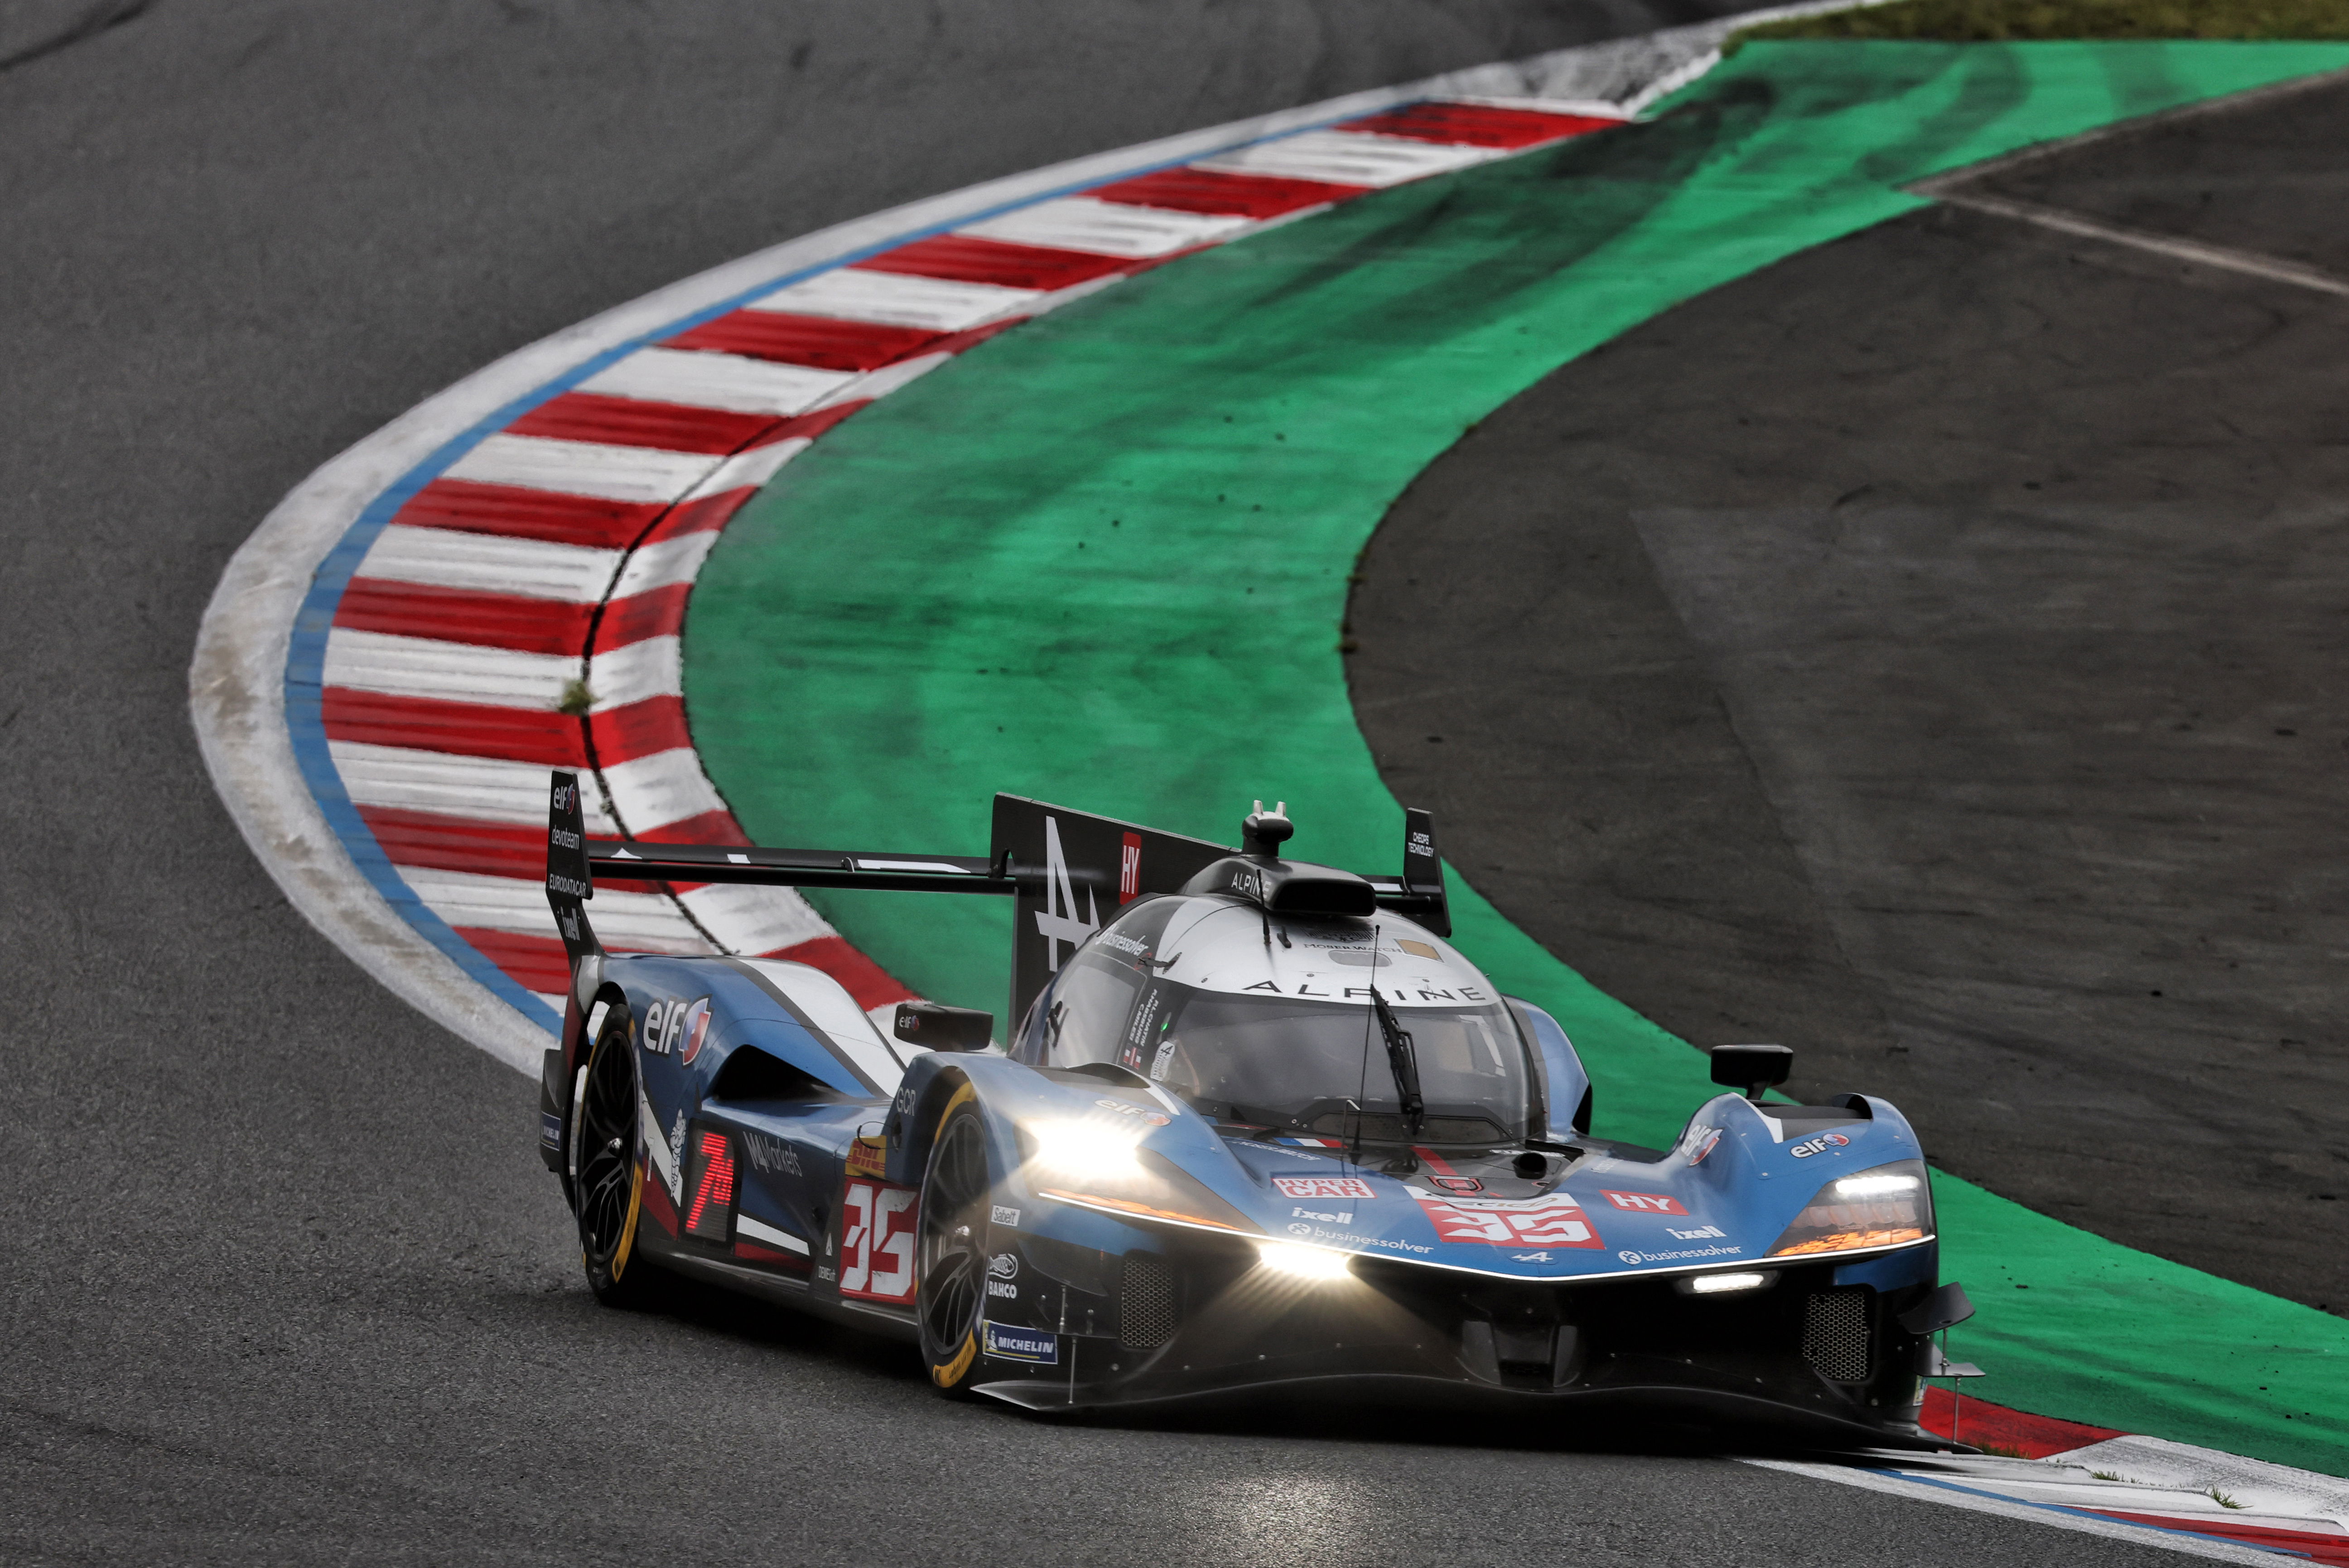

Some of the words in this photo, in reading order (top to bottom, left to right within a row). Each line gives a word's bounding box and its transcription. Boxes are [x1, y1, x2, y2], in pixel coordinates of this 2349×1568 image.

[554, 786, 568, 810] elf
[552, 825, 579, 850] devoteam
[1413, 832, 1429, 845] CHEOPS
[1408, 842, 1434, 857] TECHNOLOGY
[1121, 845, 1140, 894] HY
[549, 873, 586, 897] EURODATACAR
[1231, 872, 1272, 898] ALPINE
[560, 907, 580, 941] ixell
[1242, 980, 1486, 1001] ALPINE
[643, 1000, 687, 1054] elf
[897, 1087, 916, 1116] GCR
[1095, 1100, 1145, 1115] elf
[1791, 1138, 1827, 1158] elf
[1286, 1186, 1368, 1197] CAR
[1609, 1193, 1670, 1211] HY
[1292, 1207, 1354, 1224] ixell
[1428, 1206, 1592, 1243] 35
[839, 1183, 917, 1297] 35
[1314, 1226, 1434, 1254] businessolver
[1665, 1225, 1727, 1240] ixell
[1638, 1244, 1742, 1262] businessolver
[988, 1280, 1018, 1299] BAHCO
[998, 1336, 1054, 1354] MICHELIN
